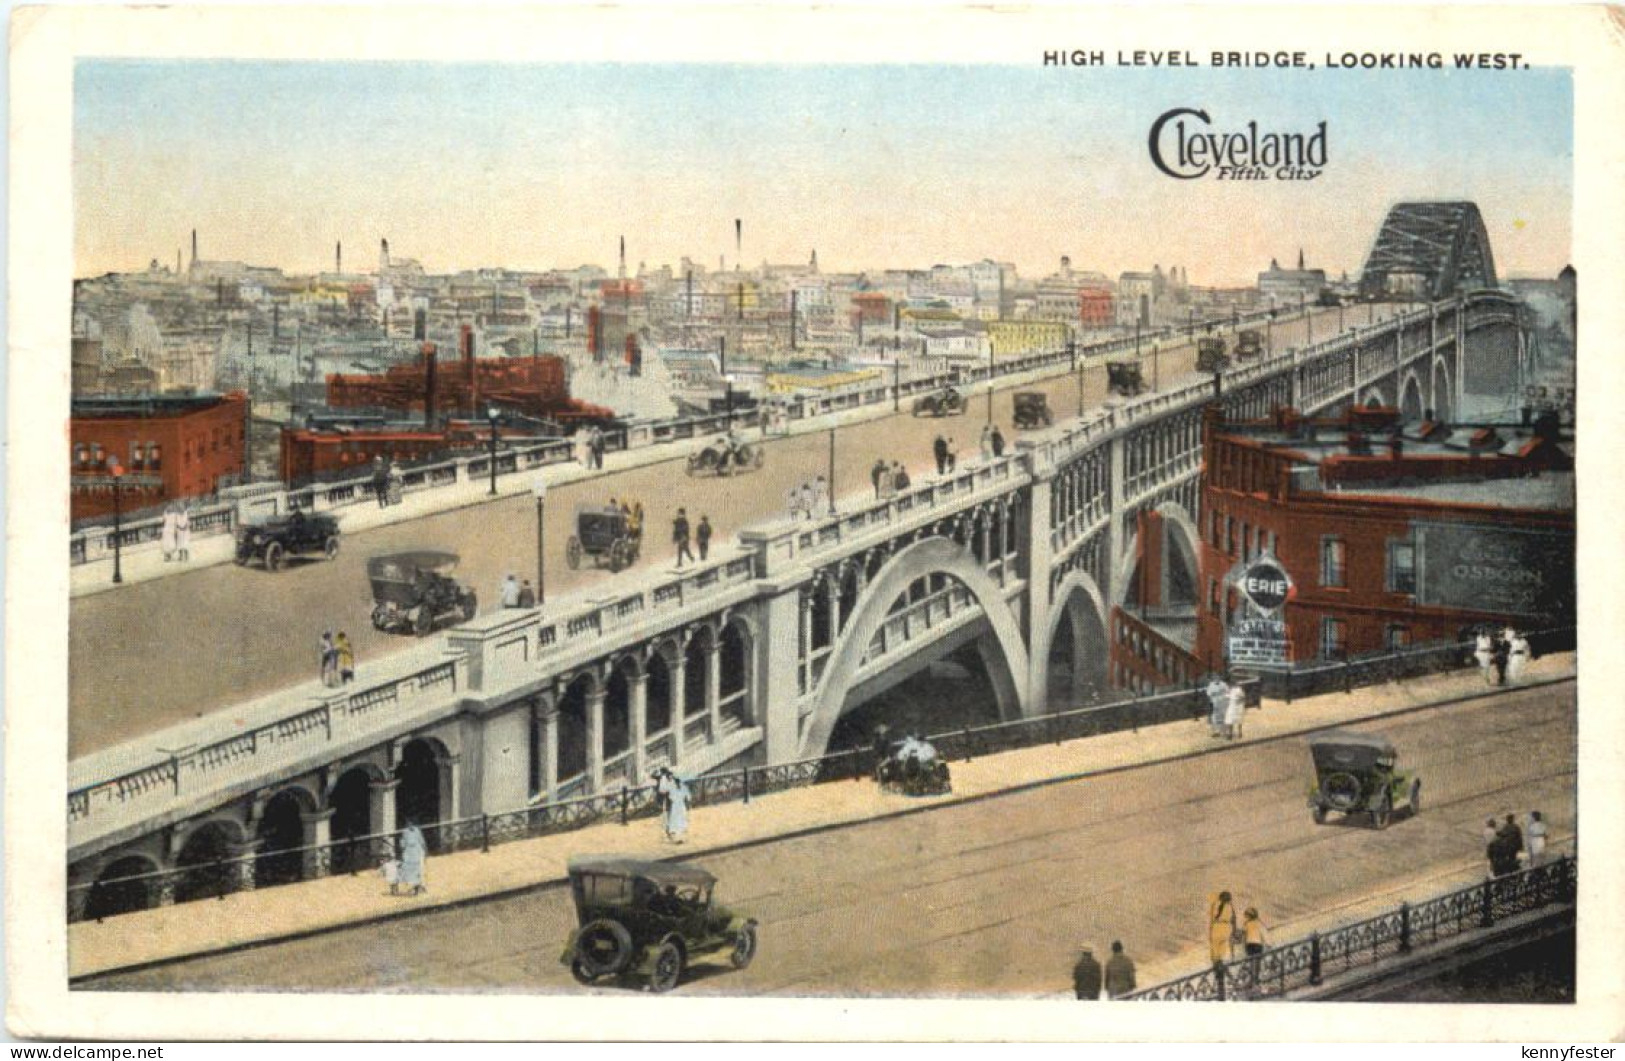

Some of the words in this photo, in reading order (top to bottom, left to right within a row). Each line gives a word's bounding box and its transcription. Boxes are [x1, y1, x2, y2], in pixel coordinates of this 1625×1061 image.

[1044, 50, 1103, 66] HIGH
[1118, 51, 1198, 66] LEVEL
[1212, 52, 1314, 70] BRIDGE,
[1327, 53, 1442, 69] LOOKING
[1454, 53, 1529, 70] WEST.
[1149, 108, 1327, 180] Cleveland
[1216, 166, 1271, 180] Fifth
[1275, 166, 1322, 180] City
[1248, 577, 1286, 596] ERIE
